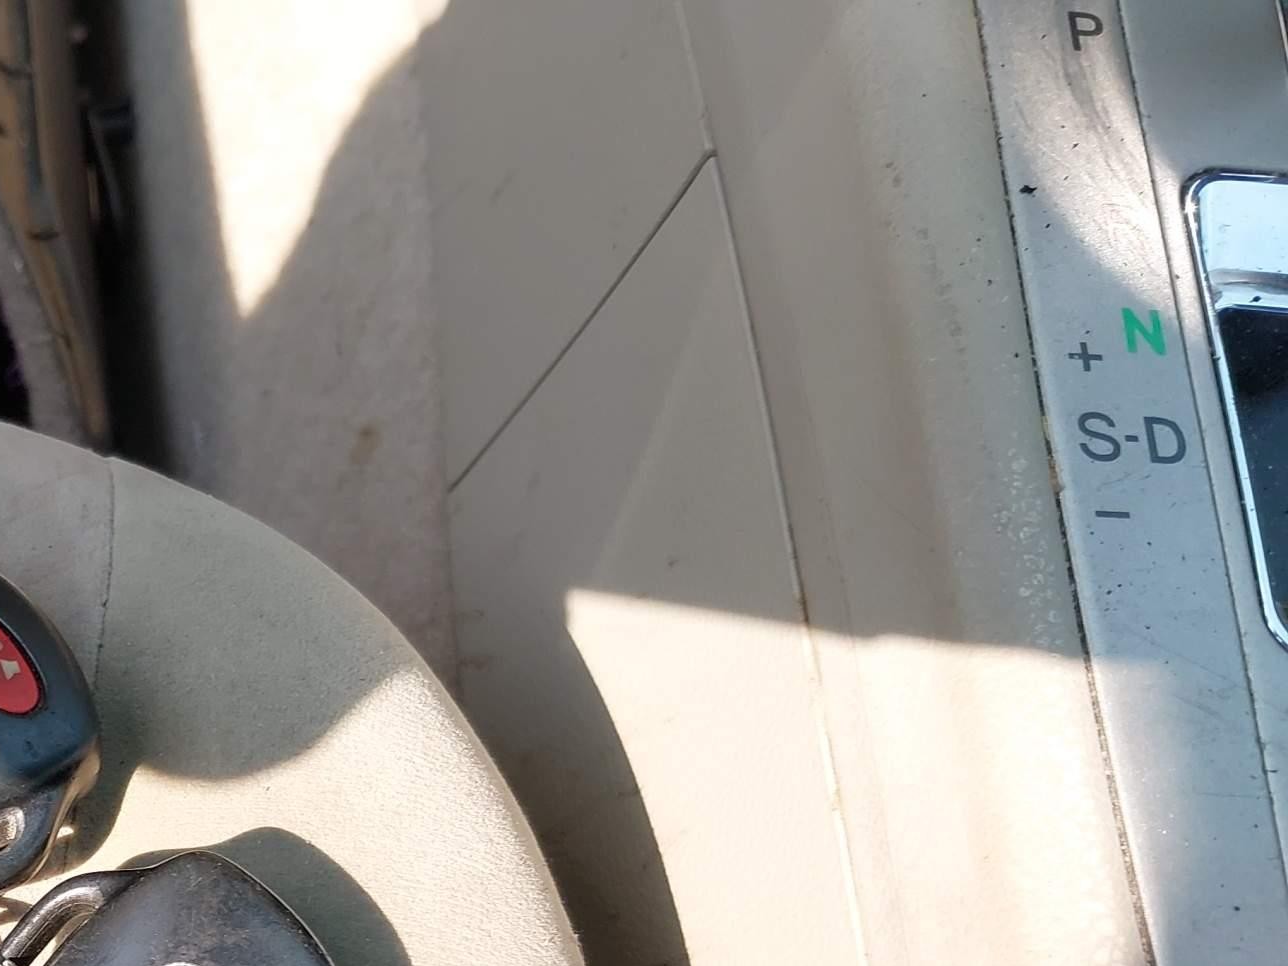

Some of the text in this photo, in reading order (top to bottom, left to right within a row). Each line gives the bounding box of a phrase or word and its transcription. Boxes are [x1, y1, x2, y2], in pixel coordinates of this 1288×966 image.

[1067, 11, 1104, 52] P
[1120, 307, 1167, 356] N
[1076, 410, 1187, 465] S-D
